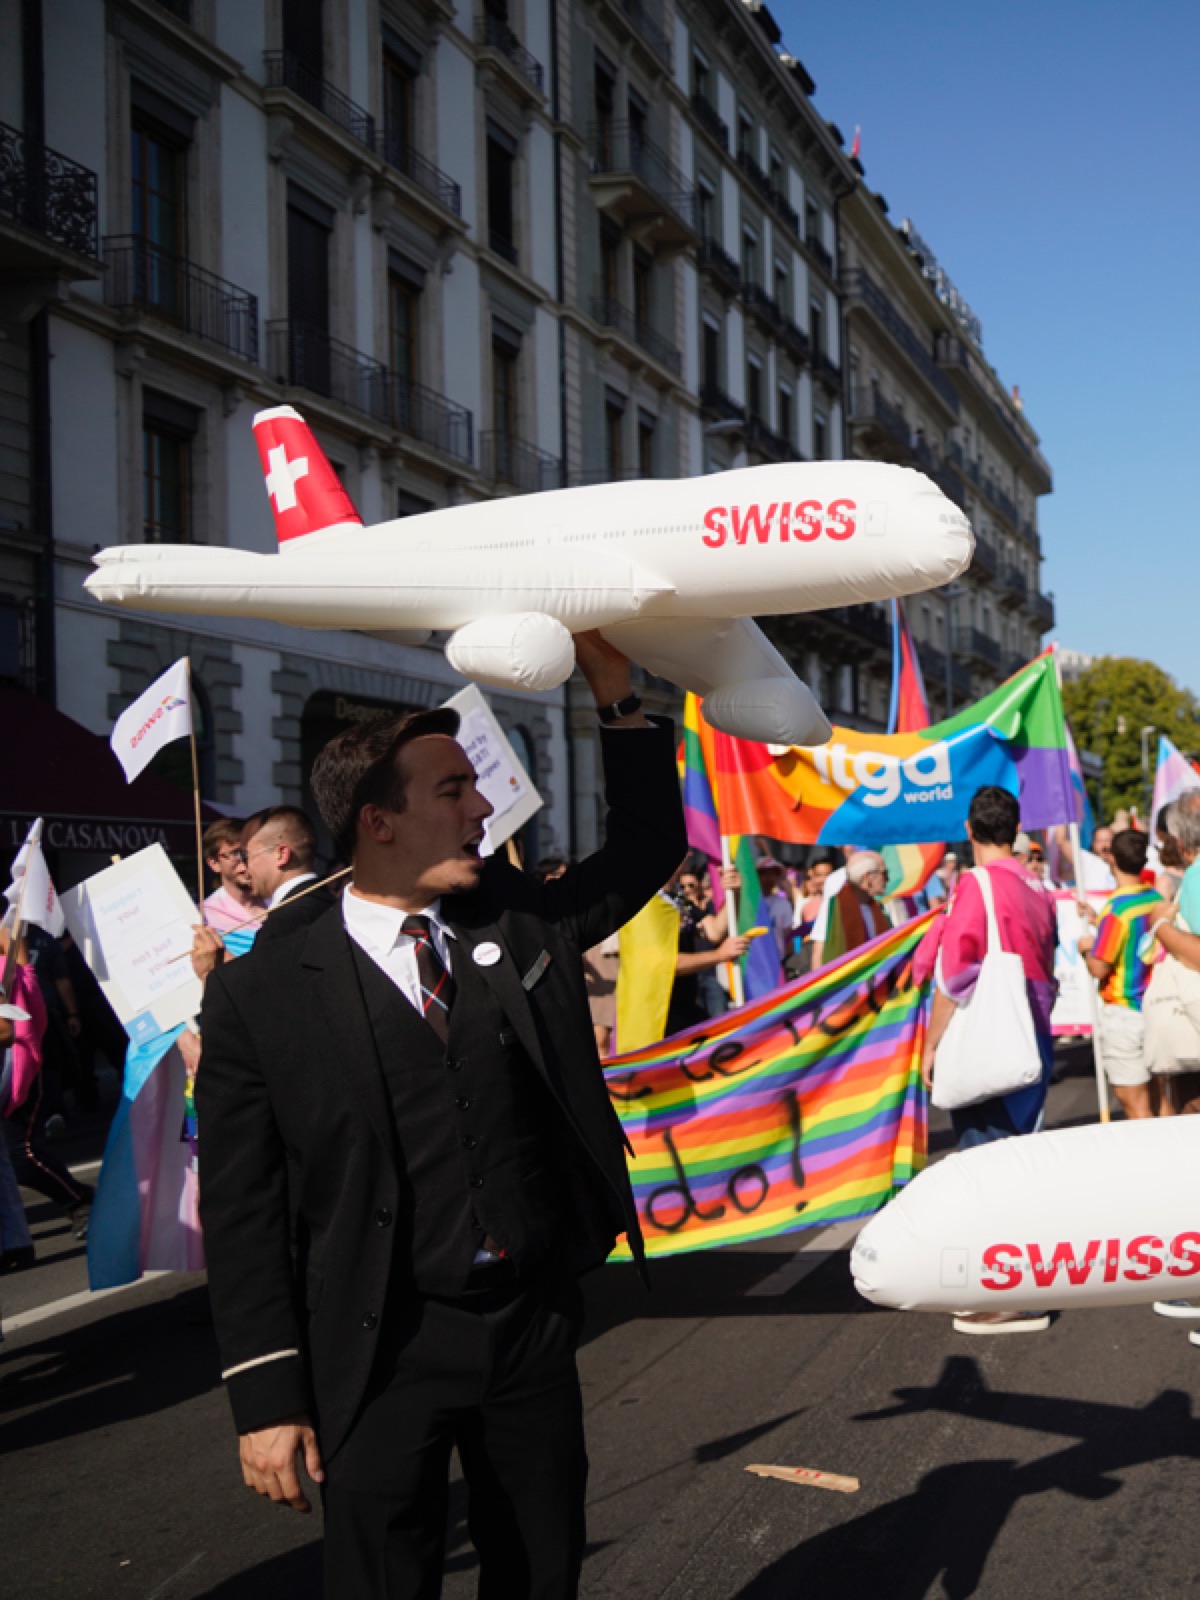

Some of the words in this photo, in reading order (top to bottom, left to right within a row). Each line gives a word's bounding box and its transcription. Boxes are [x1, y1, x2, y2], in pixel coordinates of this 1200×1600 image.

[702, 498, 857, 548] SWISS
[904, 784, 953, 804] world
[48, 822, 169, 850] CASANOVA
